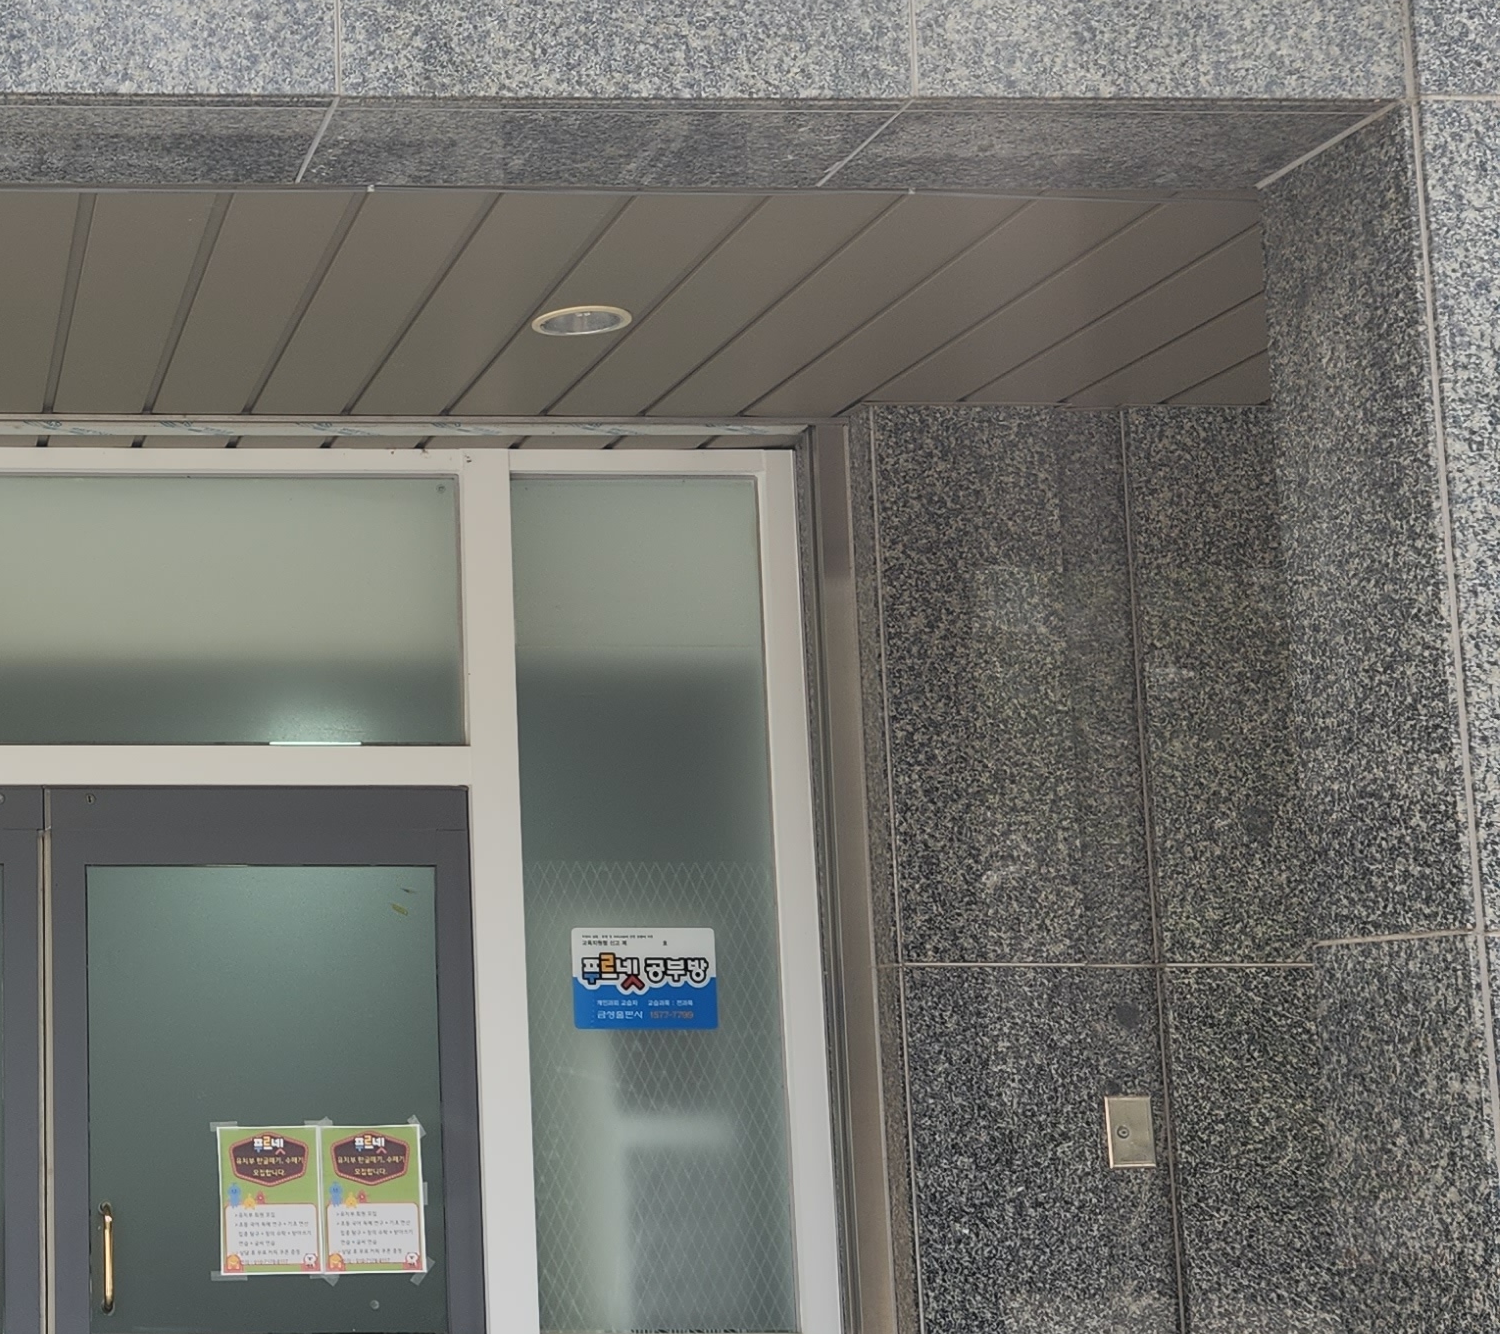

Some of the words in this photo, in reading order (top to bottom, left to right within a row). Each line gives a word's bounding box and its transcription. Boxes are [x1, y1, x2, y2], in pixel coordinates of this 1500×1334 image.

[581, 952, 645, 991] 푸르넷
[644, 957, 709, 984] 공부방
[596, 1010, 643, 1020] 금성출판사
[253, 1136, 286, 1155] 푸르넷
[355, 1135, 387, 1154] 푸르넷
[236, 1157, 255, 1165] 유치부
[338, 1156, 356, 1164] 유치부
